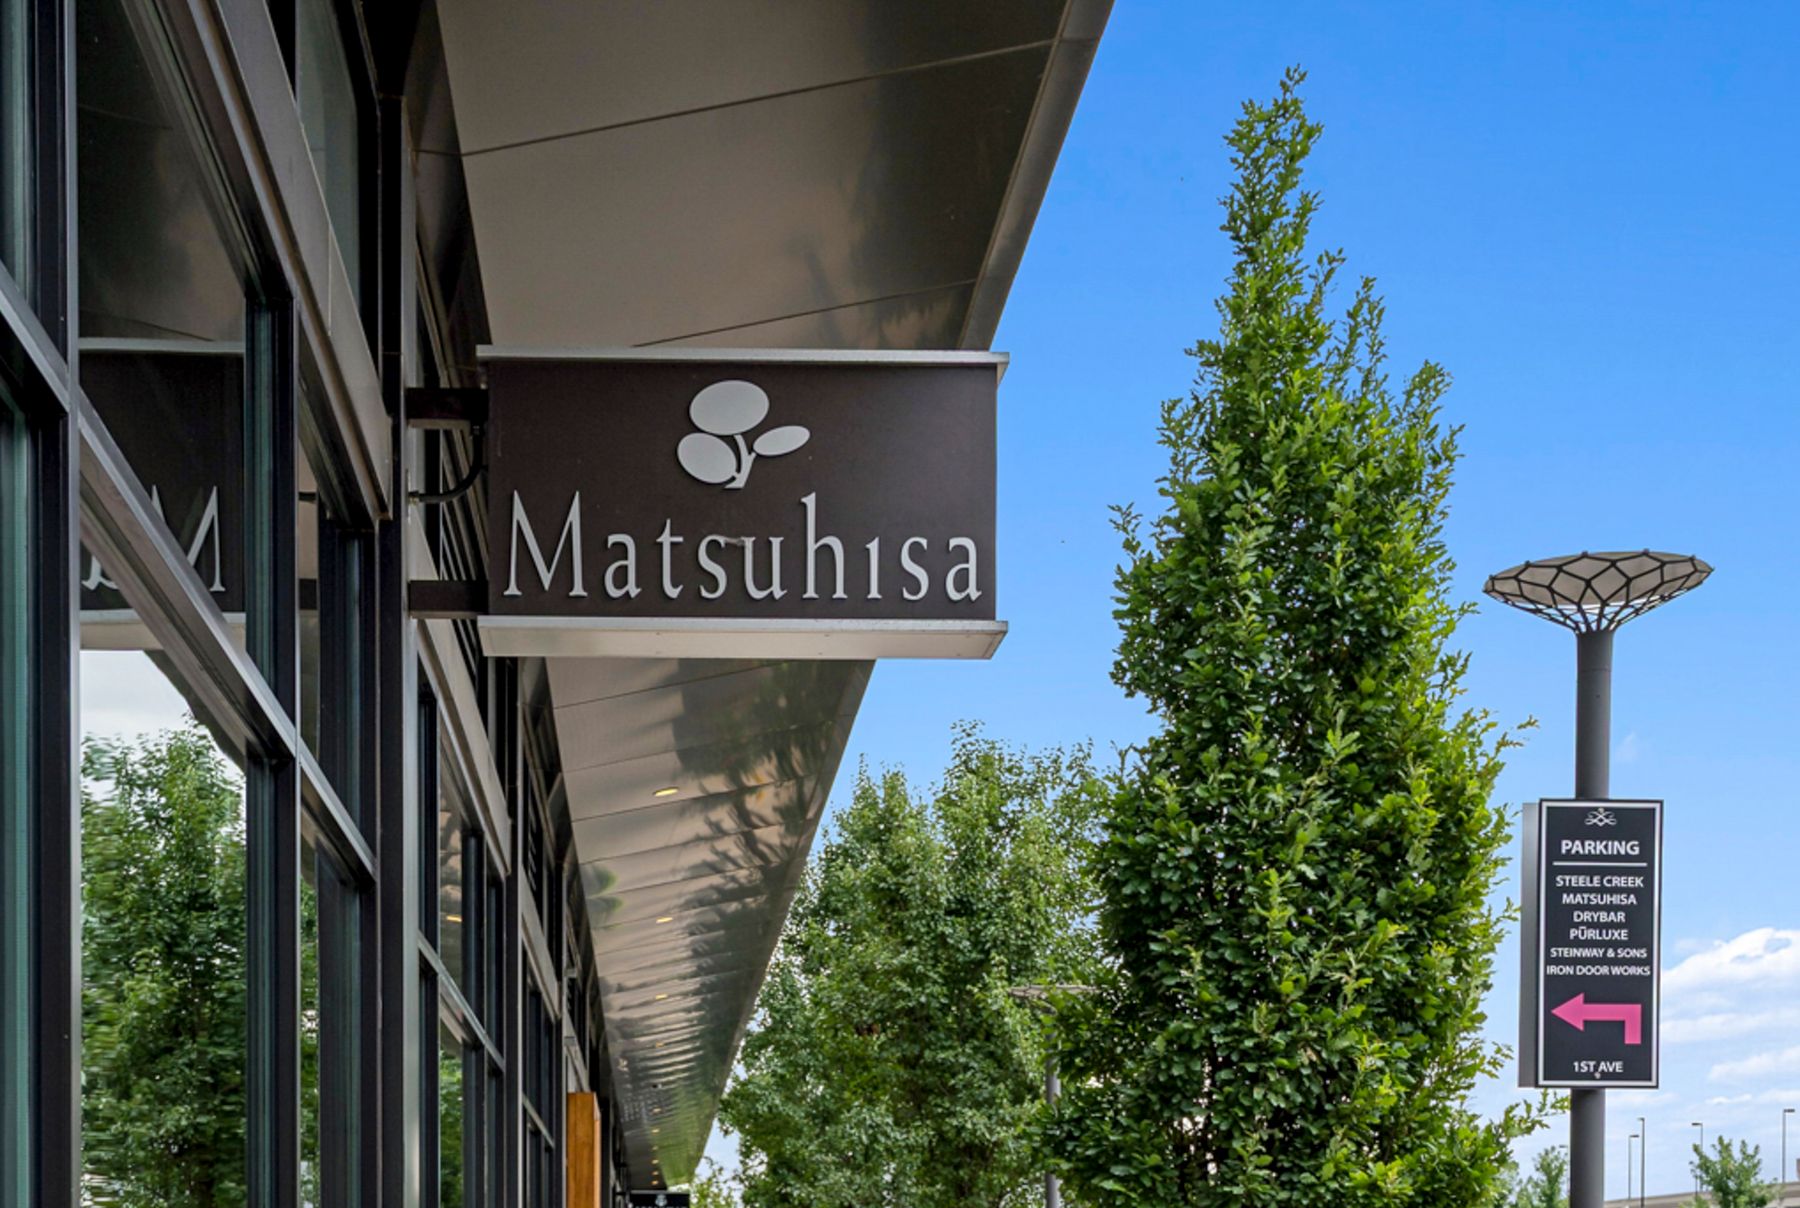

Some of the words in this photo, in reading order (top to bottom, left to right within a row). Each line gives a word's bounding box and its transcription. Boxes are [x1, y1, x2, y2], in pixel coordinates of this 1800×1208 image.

[503, 490, 982, 601] Matsuhisa
[1560, 840, 1640, 856] PARKING
[1555, 875, 1601, 888] STEELE
[1602, 875, 1644, 888] CREEK
[1562, 893, 1638, 906] MATSUHISA
[1573, 910, 1626, 923] DRYBAR
[1550, 947, 1605, 959] STEINWAY
[1606, 947, 1616, 959] &
[1617, 947, 1648, 959] SONS
[1546, 965, 1575, 976] IRON
[1576, 965, 1610, 976] DOOR
[1611, 965, 1651, 977] WORKS
[1573, 1061, 1597, 1073] 1ST
[1598, 1061, 1624, 1073] AVE
